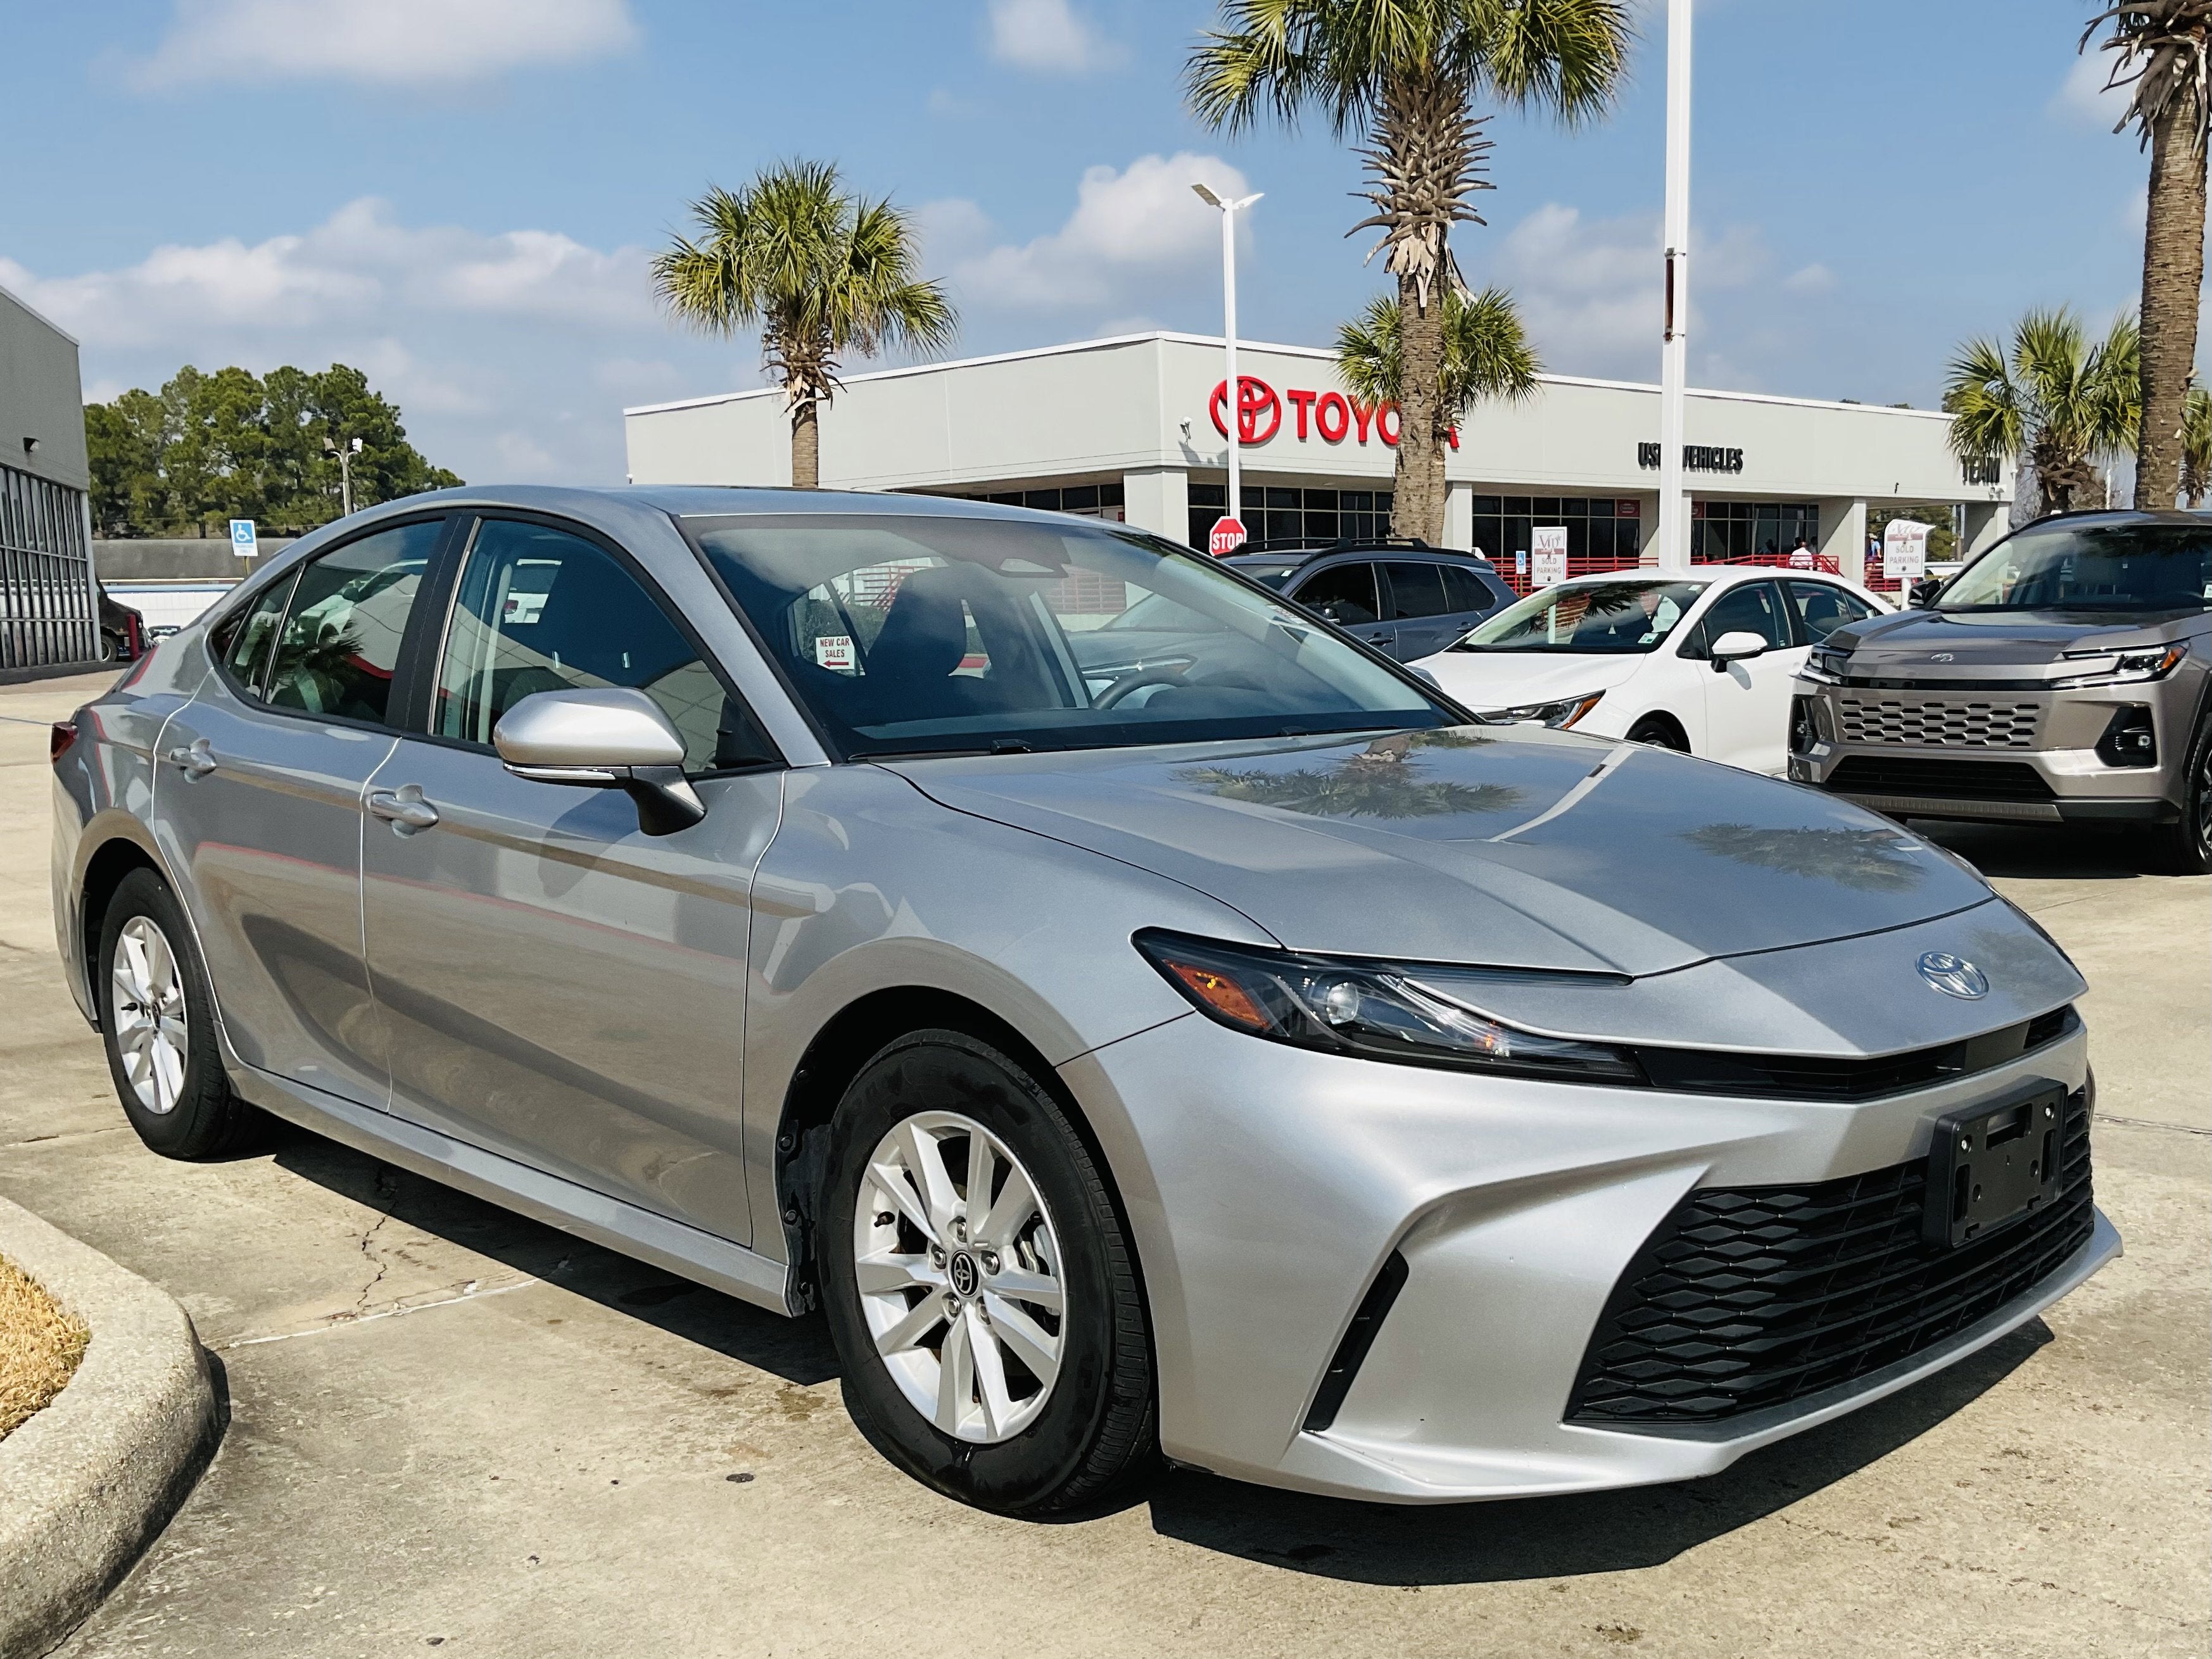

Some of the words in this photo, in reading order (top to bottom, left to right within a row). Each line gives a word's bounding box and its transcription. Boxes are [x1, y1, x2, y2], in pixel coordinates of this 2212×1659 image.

[1287, 389, 1459, 448] TOYO
[1683, 445, 1743, 470] VEHICLES
[1961, 455, 2000, 483] TEAM
[1212, 533, 1244, 550] STOP
[820, 638, 834, 647] NEW
[837, 638, 850, 646] CAR
[826, 649, 845, 657] SALES
